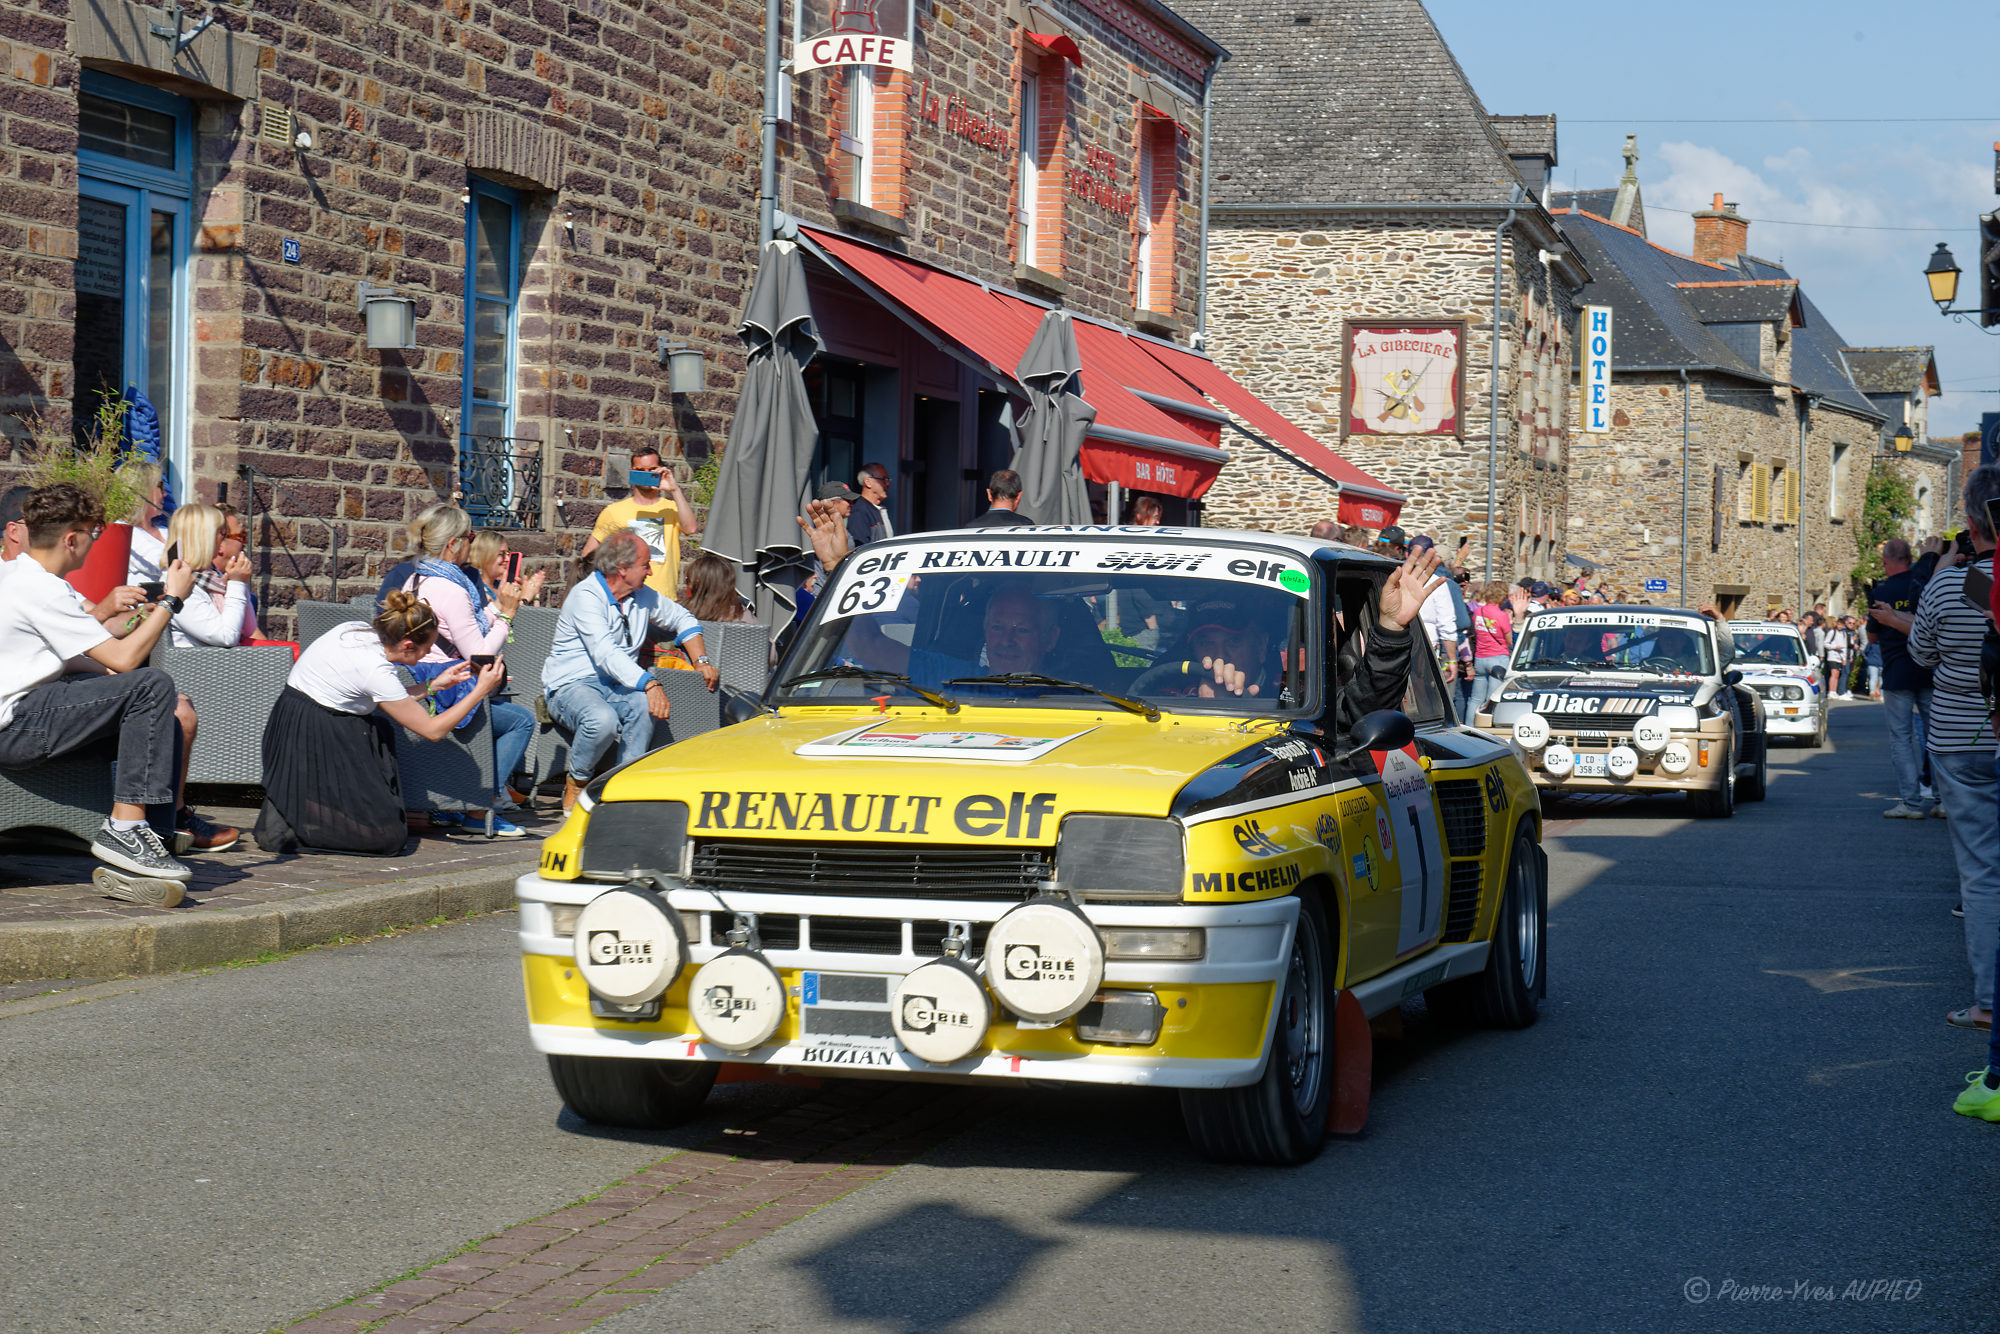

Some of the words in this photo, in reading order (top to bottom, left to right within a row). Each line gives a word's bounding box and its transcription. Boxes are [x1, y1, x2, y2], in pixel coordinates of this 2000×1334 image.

[812, 38, 895, 64] CAFE
[919, 78, 940, 123] La
[286, 242, 296, 258] 24
[1358, 344, 1377, 358] LA
[1380, 339, 1452, 359] GIBECIERE
[1592, 311, 1607, 428] HOTEL
[1136, 462, 1150, 480] BAR
[856, 551, 909, 575] elf
[919, 550, 1080, 569] RENAULT
[1227, 559, 1286, 582] elf
[838, 576, 891, 614] 63
[1537, 616, 1558, 628] 62
[1566, 615, 1608, 624] Team
[1618, 615, 1655, 625] Diac
[1503, 692, 1533, 700] elf
[1534, 693, 1600, 714] Diac
[1659, 695, 1691, 704] elf
[1485, 765, 1508, 814] elf
[694, 791, 941, 835] RENAULT
[954, 792, 1057, 839] elf
[1340, 796, 1370, 817] LONGINES
[1233, 819, 1288, 857] elf
[1192, 863, 1301, 893] MICHELIN
[1406, 805, 1428, 934] 1
